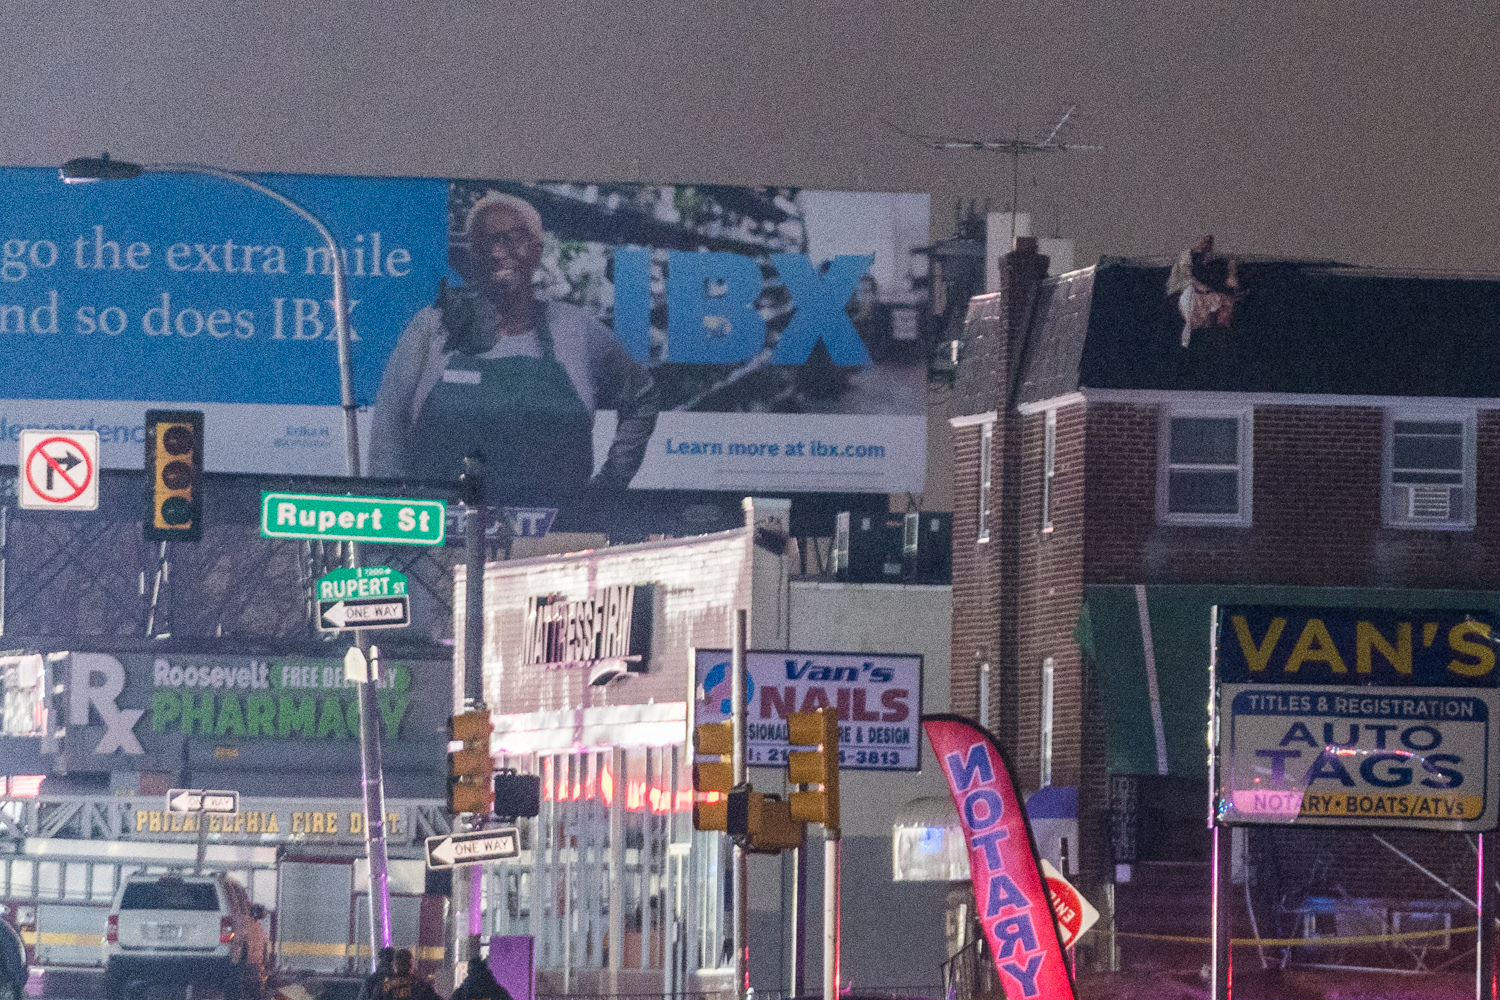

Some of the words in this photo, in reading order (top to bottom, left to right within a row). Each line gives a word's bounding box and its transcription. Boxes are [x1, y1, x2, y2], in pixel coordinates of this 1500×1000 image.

[1, 237, 59, 282] go
[73, 225, 152, 271] the
[166, 243, 288, 275] extra
[304, 232, 412, 278] mile
[0, 290, 59, 335] nd
[76, 305, 128, 337] so
[142, 293, 255, 339] does
[271, 297, 362, 343] IBX
[613, 245, 876, 367] IBX
[666, 438, 723, 456] Learn
[728, 441, 780, 457] more
[784, 440, 805, 457] at
[810, 439, 886, 458] ibx.com
[276, 502, 383, 532] Rupert
[397, 506, 430, 532] St
[320, 577, 390, 599] RUPERT
[393, 580, 406, 594] ST
[346, 605, 371, 619] ONE
[374, 604, 400, 617] WAY
[1231, 615, 1496, 677] VAN'S
[153, 658, 270, 690] Roosevelt
[281, 665, 319, 689] FREE
[784, 659, 896, 682] Van's
[152, 690, 411, 739] PHARMACY
[759, 684, 910, 722] NAILS
[1249, 694, 1311, 712] TITLES
[1317, 696, 1329, 711] &
[1336, 697, 1474, 717] REGISTRATION
[749, 723, 789, 741] SIONAL
[856, 727, 863, 743] &
[868, 727, 911, 744] DESIGN
[1278, 722, 1443, 751] AUTO
[1255, 749, 1464, 789] TAGS
[1254, 794, 1332, 813] NOTARY
[136, 810, 280, 835] PHILAELPHIA
[292, 811, 338, 835] FIRE
[350, 811, 404, 835] DT.
[454, 841, 479, 856] ONE
[480, 837, 509, 852] WAY
